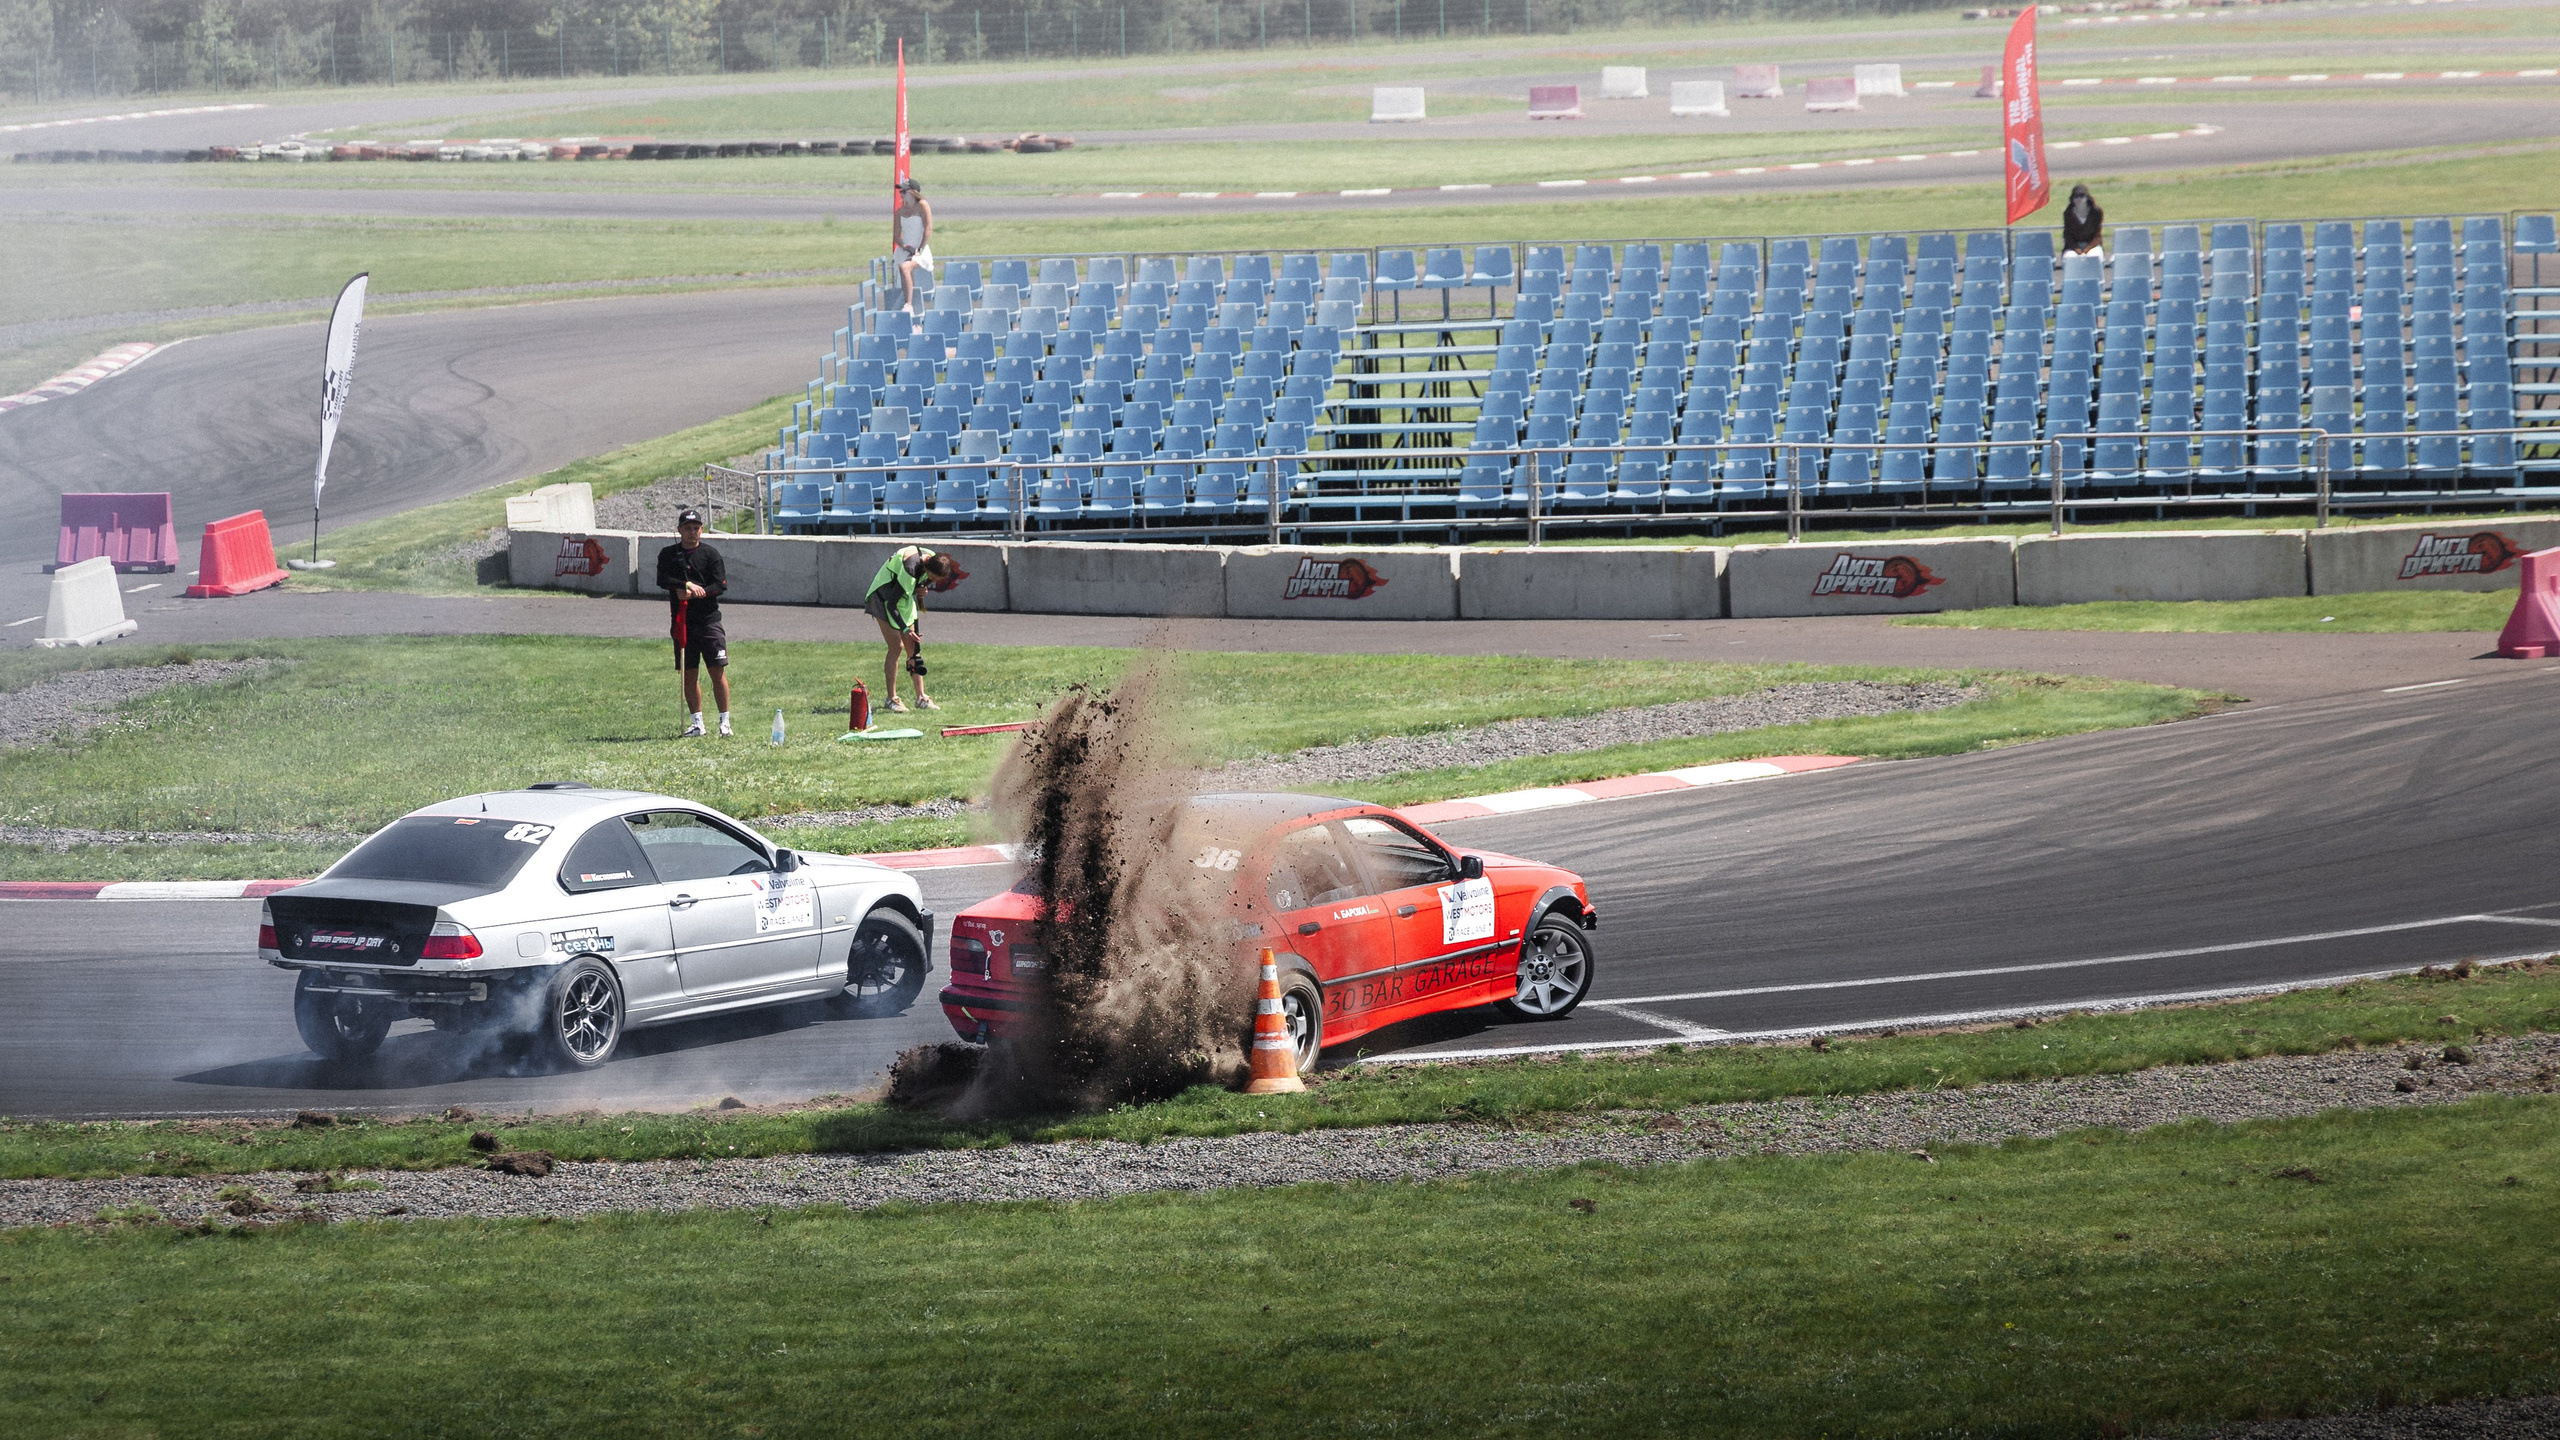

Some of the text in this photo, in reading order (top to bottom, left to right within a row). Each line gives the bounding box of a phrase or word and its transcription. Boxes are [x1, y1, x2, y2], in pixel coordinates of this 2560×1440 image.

[503, 823, 553, 845] 82
[1194, 847, 1242, 872] 36
[768, 877, 806, 890] Valvoline
[757, 893, 810, 909] WESTMOTORS
[1456, 886, 1490, 901] Valvoline
[1446, 903, 1492, 919] WESTMOTORS
[365, 937, 384, 948] DAY
[551, 933, 565, 943] НА
[1328, 951, 1497, 1016] 30 BAR GARAGE
